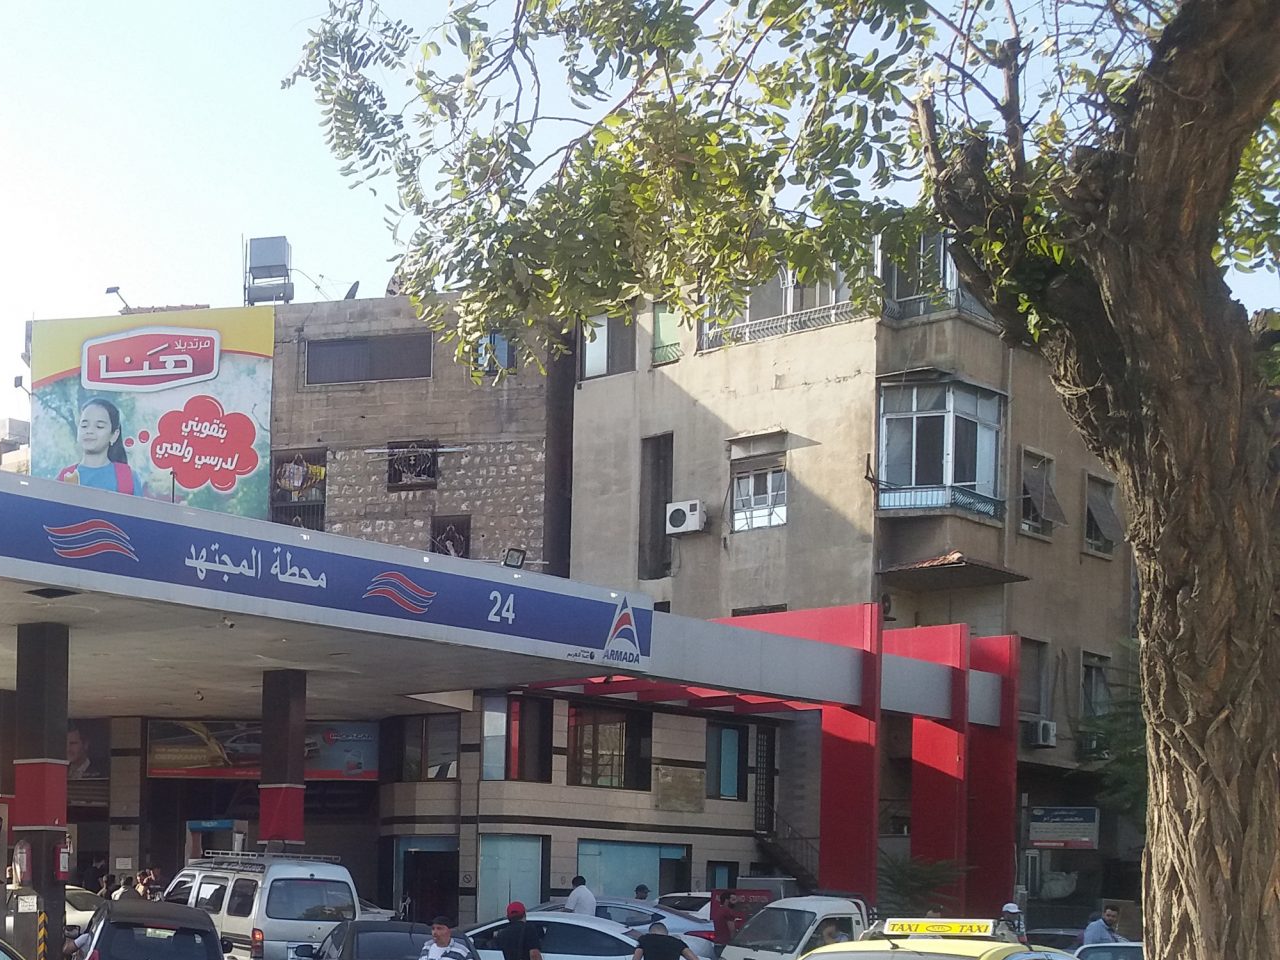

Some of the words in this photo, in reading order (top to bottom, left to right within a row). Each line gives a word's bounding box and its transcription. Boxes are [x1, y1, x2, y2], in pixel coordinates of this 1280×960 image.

[174, 338, 211, 350] مرتديلا
[181, 416, 228, 443] بتقويني
[155, 440, 194, 463] ولعبي
[185, 542, 262, 582] المجتهد
[270, 546, 327, 589] محطة
[488, 590, 516, 625] 24
[602, 649, 640, 665] ARMADA
[889, 923, 920, 933] TAXI
[959, 924, 990, 933] TAXI
